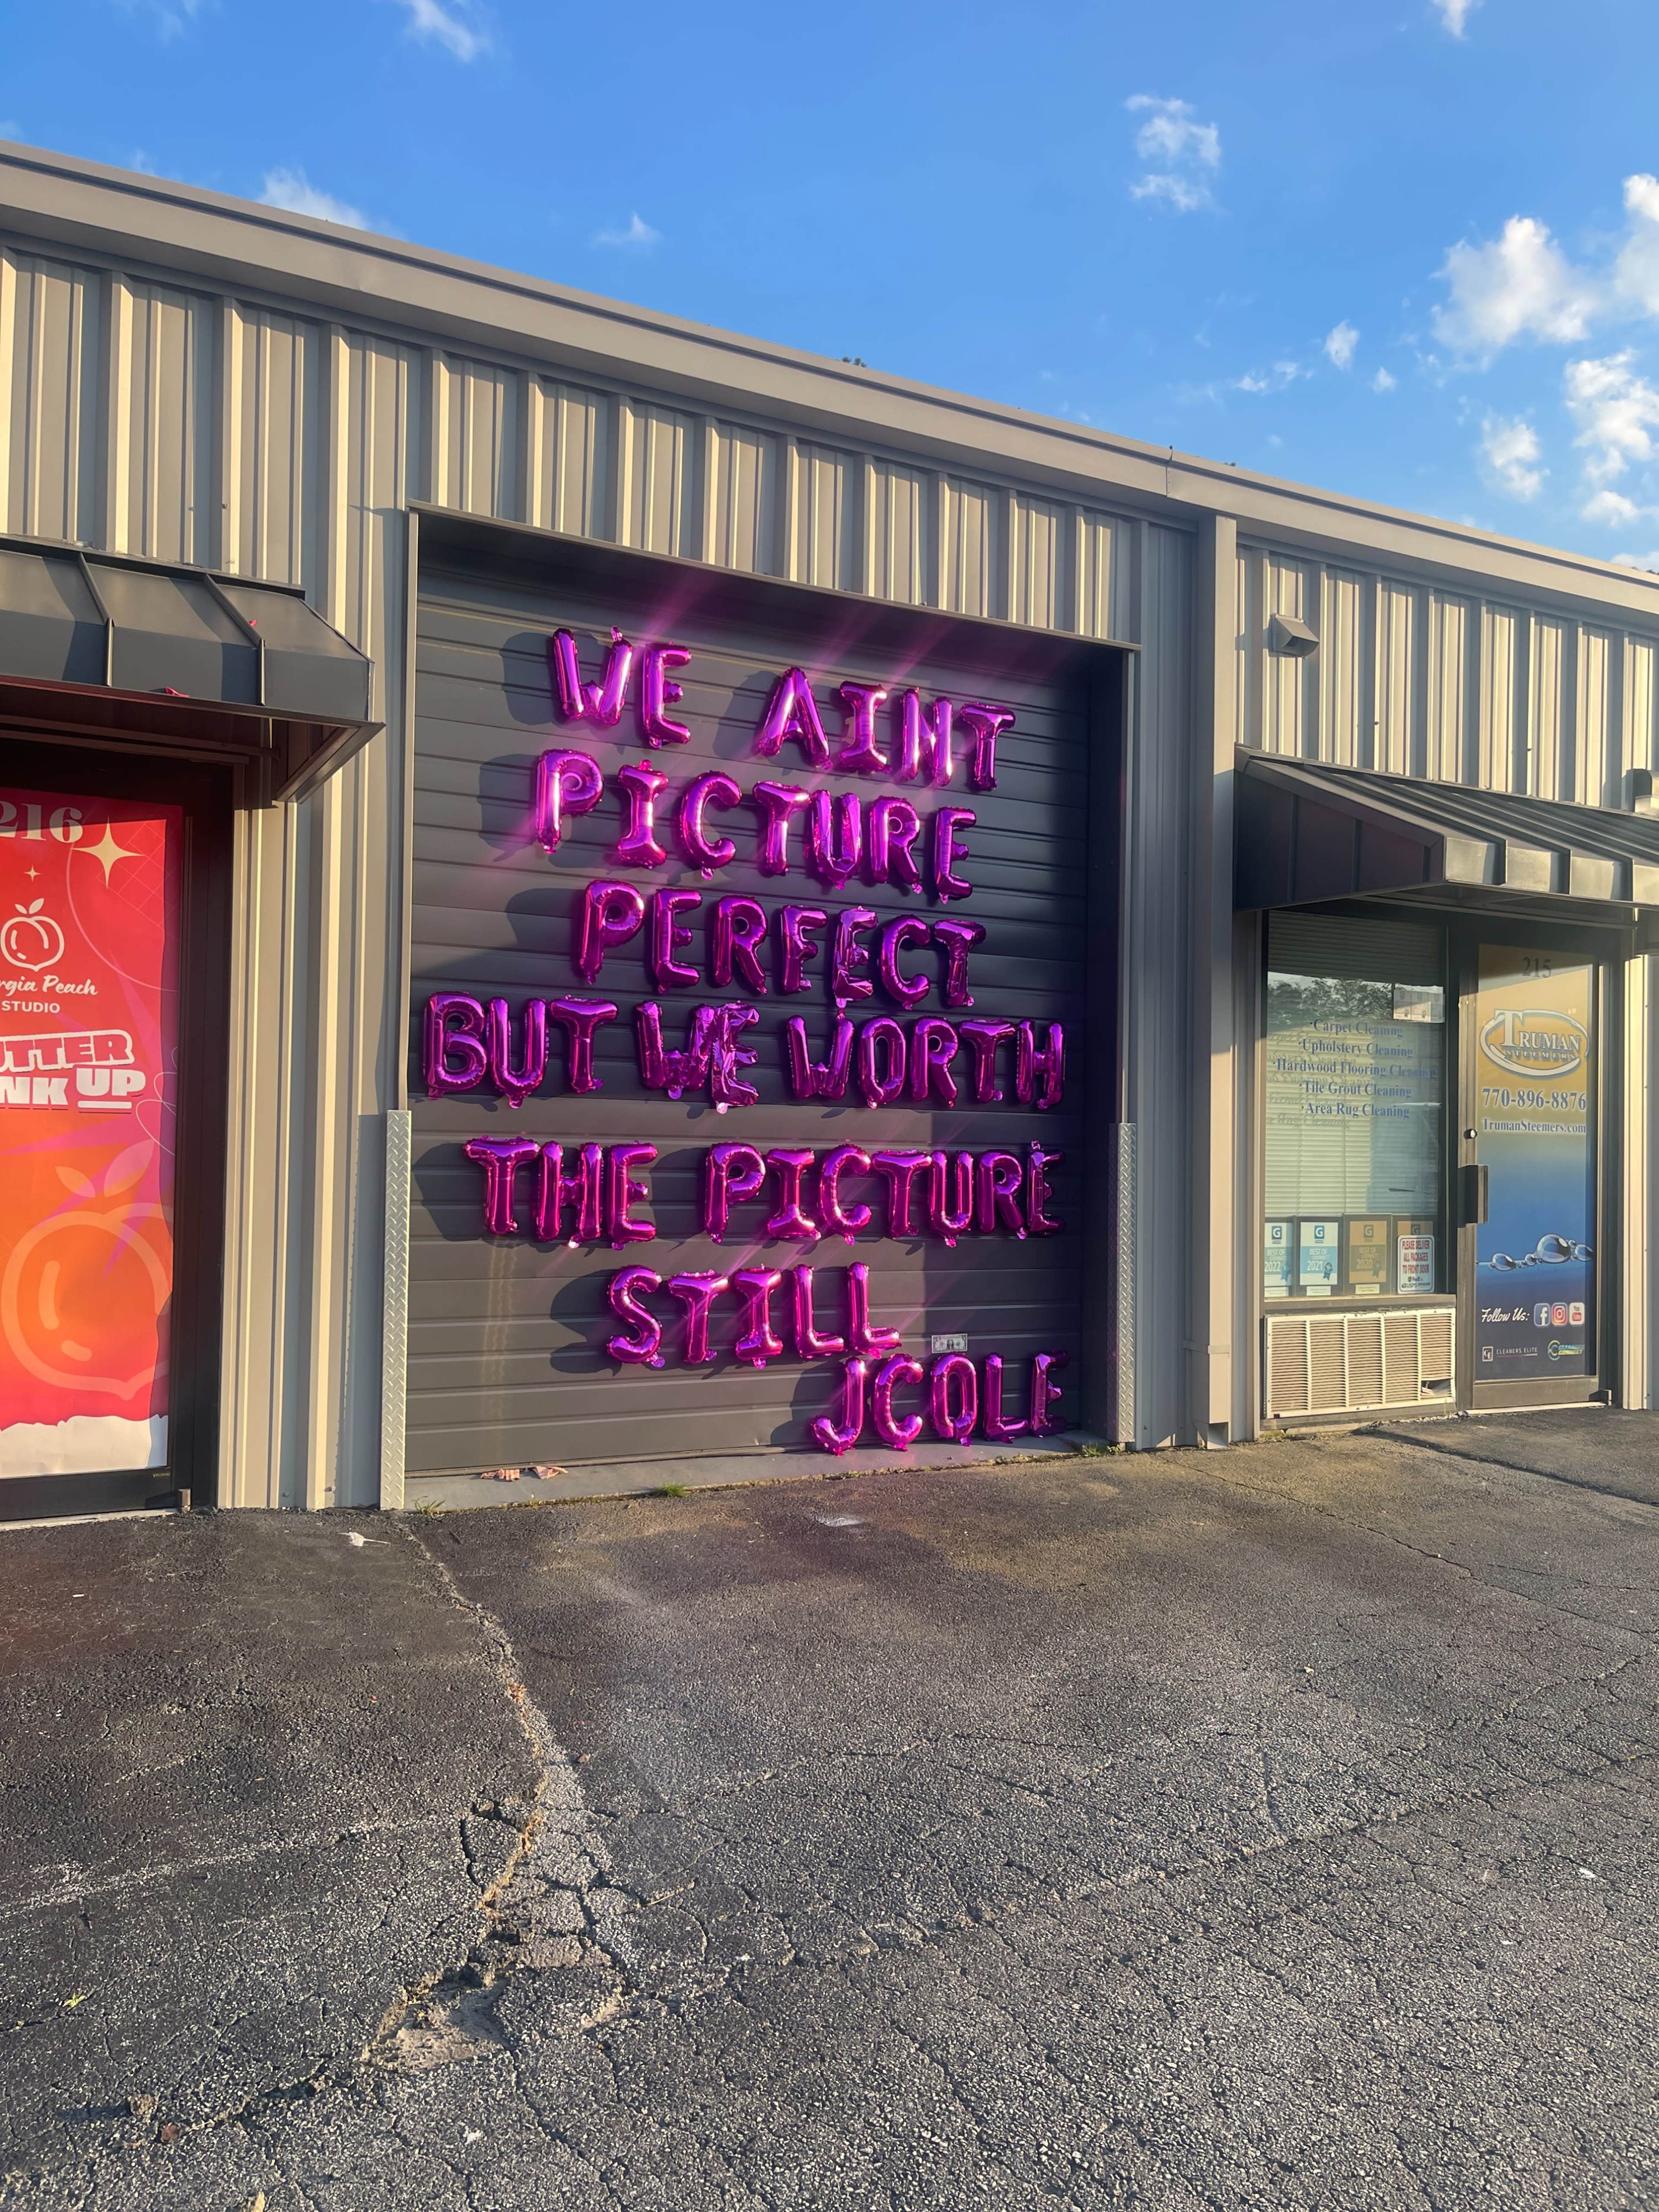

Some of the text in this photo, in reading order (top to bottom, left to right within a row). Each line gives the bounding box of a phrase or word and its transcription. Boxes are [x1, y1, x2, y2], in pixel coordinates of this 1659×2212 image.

[553, 626, 1016, 791] WE AINT
[0, 801, 83, 843] 216
[535, 748, 977, 901] PICTURE
[584, 879, 987, 1010] PERFECT
[1522, 956, 1552, 979] 215
[42, 974, 99, 995] Peach
[1, 1000, 60, 1013] STUDIO
[1313, 1018, 1403, 1040] Carpet Cleaning
[1494, 1009, 1580, 1052] TRUMAN
[0, 1030, 133, 1071] TTER
[423, 991, 1066, 1113] BUT WE WORTH
[1303, 1039, 1414, 1061] Upholstery Cleaning
[1506, 1050, 1576, 1060] STEEMERS
[1277, 1058, 1336, 1073] Hardwood
[1341, 1061, 1386, 1079] Flooring
[76, 1068, 146, 1096] UP
[1303, 1080, 1412, 1099] Tile Grout Cleaning
[1482, 1088, 1586, 1110] 770-896-8876
[1306, 1102, 1410, 1119] Area Rug Cleaning
[1482, 1118, 1586, 1133] TrumanSteemers.com
[464, 1136, 1066, 1250] THE PICTURE
[1402, 1240, 1430, 1250] PLEASE DELIVER
[1307, 1260, 1323, 1271] 2021
[607, 1262, 901, 1368] STILL
[1481, 1307, 1530, 1322] Follow Us:
